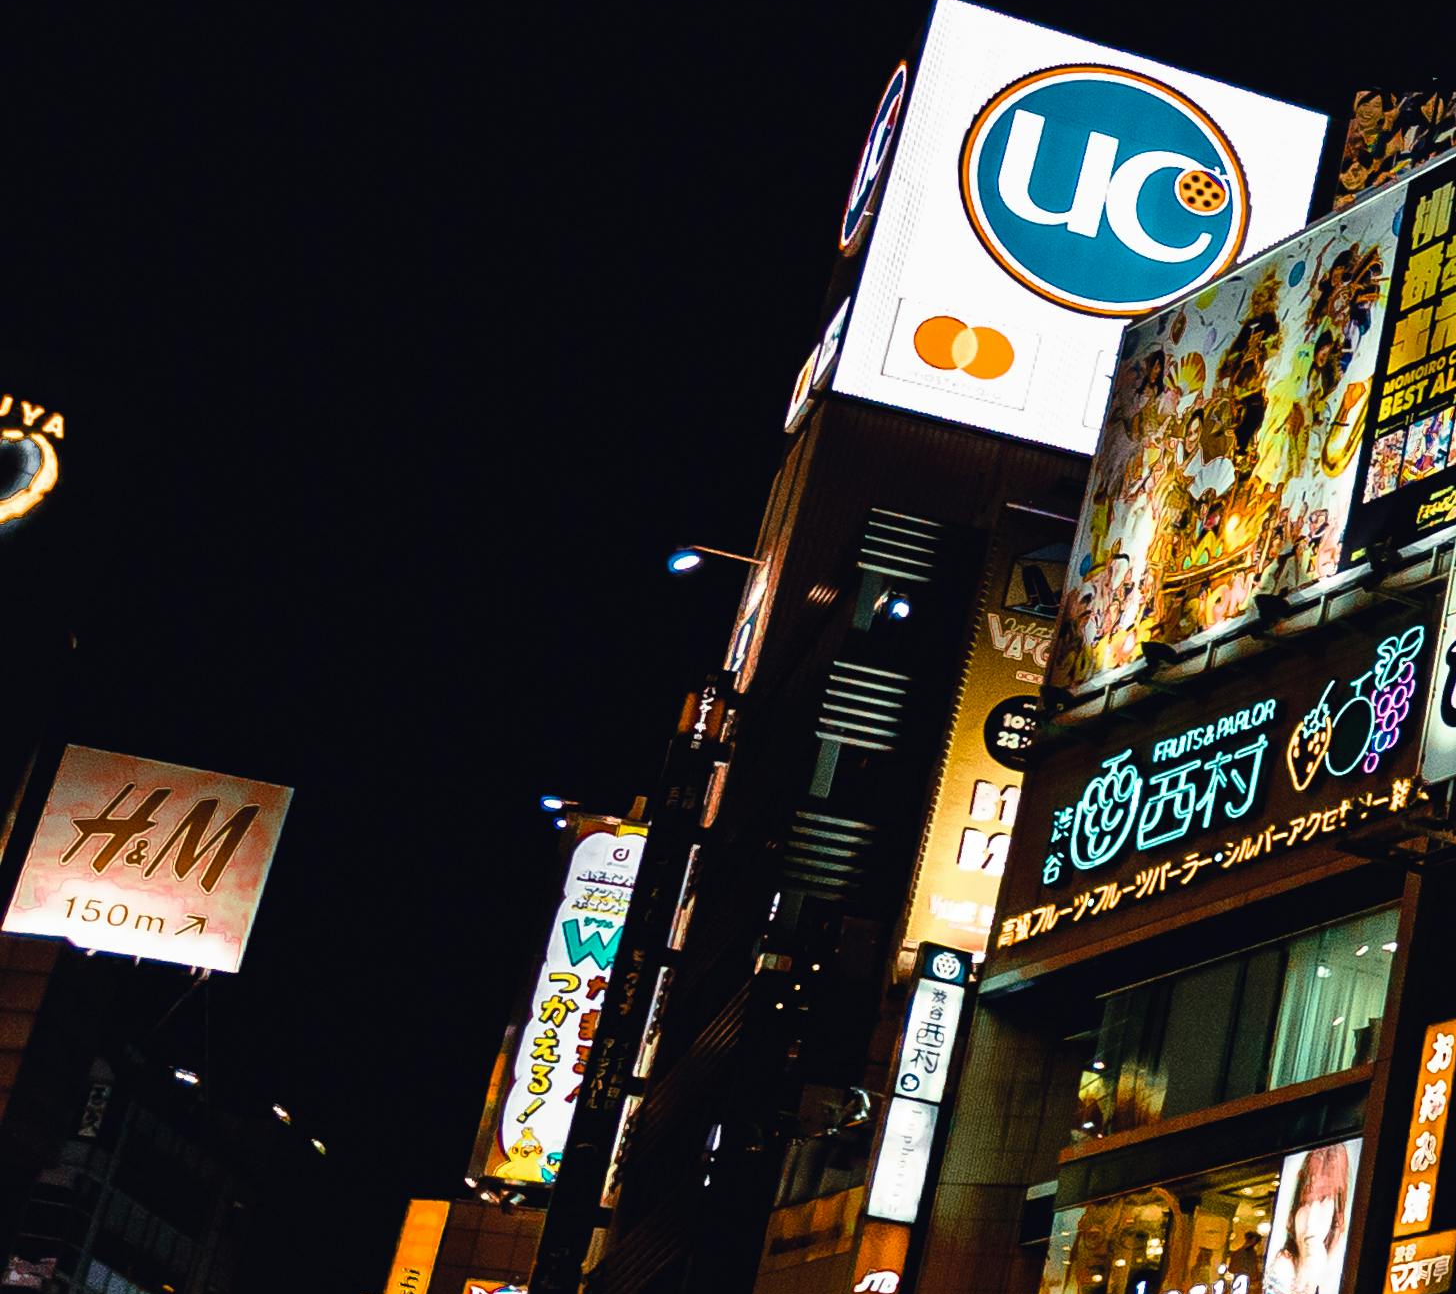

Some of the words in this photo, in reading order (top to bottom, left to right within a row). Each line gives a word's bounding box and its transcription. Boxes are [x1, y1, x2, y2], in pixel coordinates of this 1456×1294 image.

[1377, 376, 1430, 424] BEST
[1382, 356, 1446, 396] MOMOIRO
[1136, 733, 1269, 852] 西村
[59, 783, 260, 895] H&M
